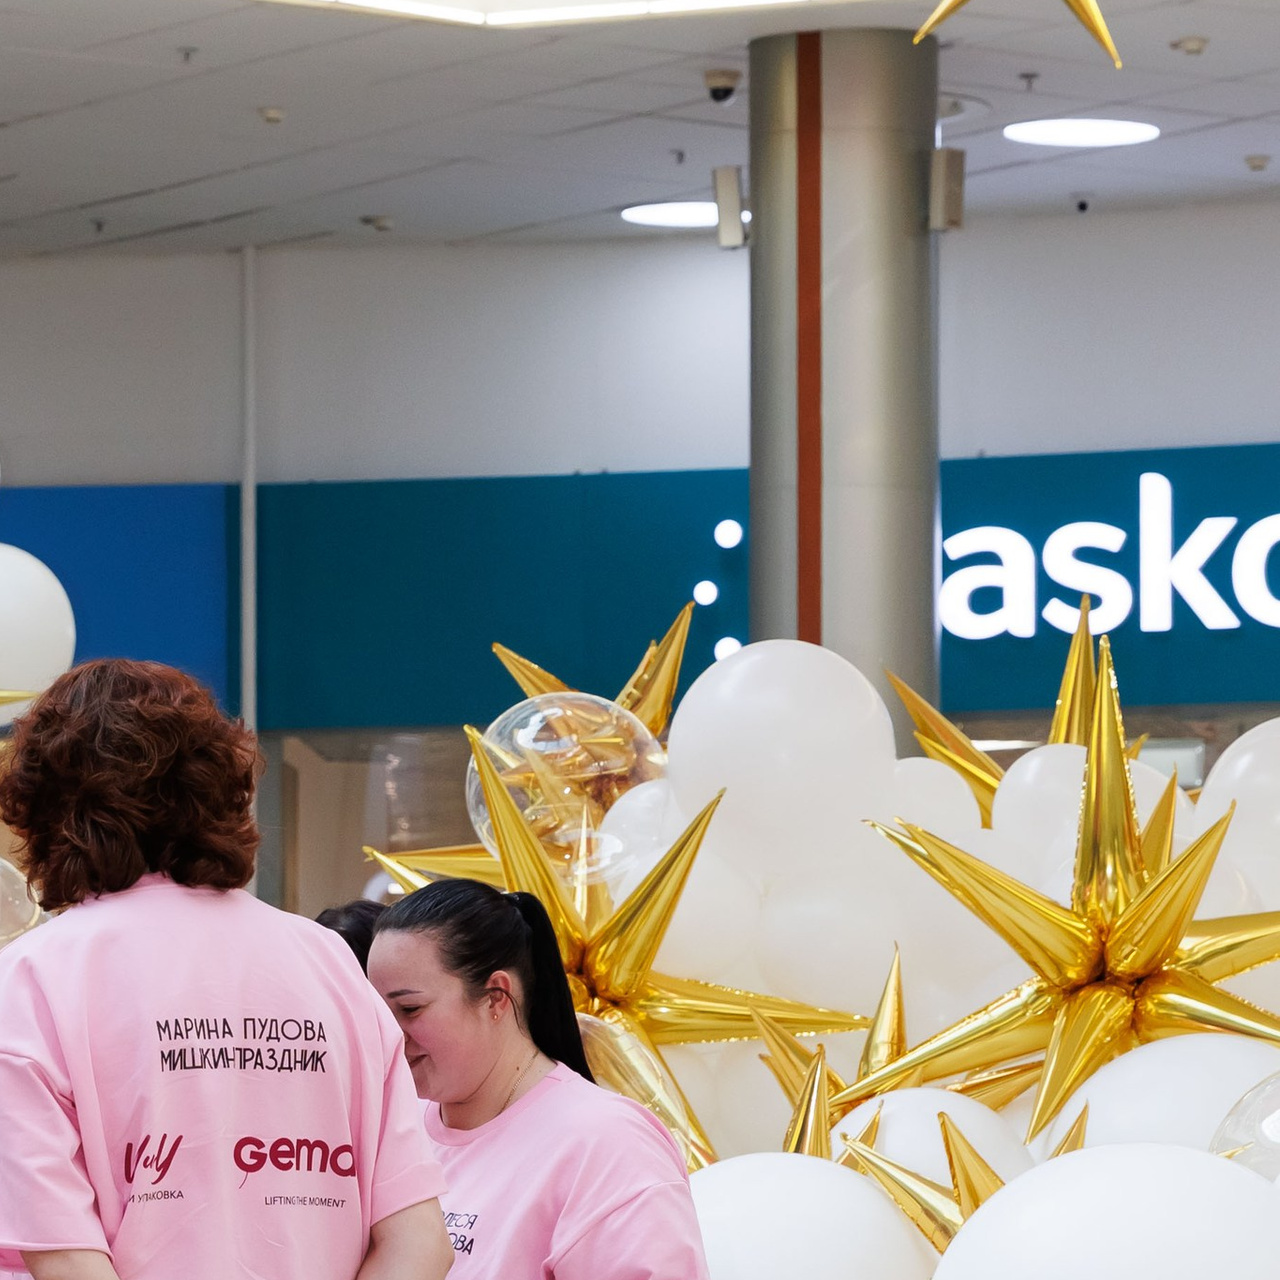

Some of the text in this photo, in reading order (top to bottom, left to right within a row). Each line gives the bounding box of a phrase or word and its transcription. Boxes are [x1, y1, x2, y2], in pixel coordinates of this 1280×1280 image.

[156, 1017, 328, 1042] МАРИНА ПУДОВА
[309, 1197, 347, 1208] MOMENT
